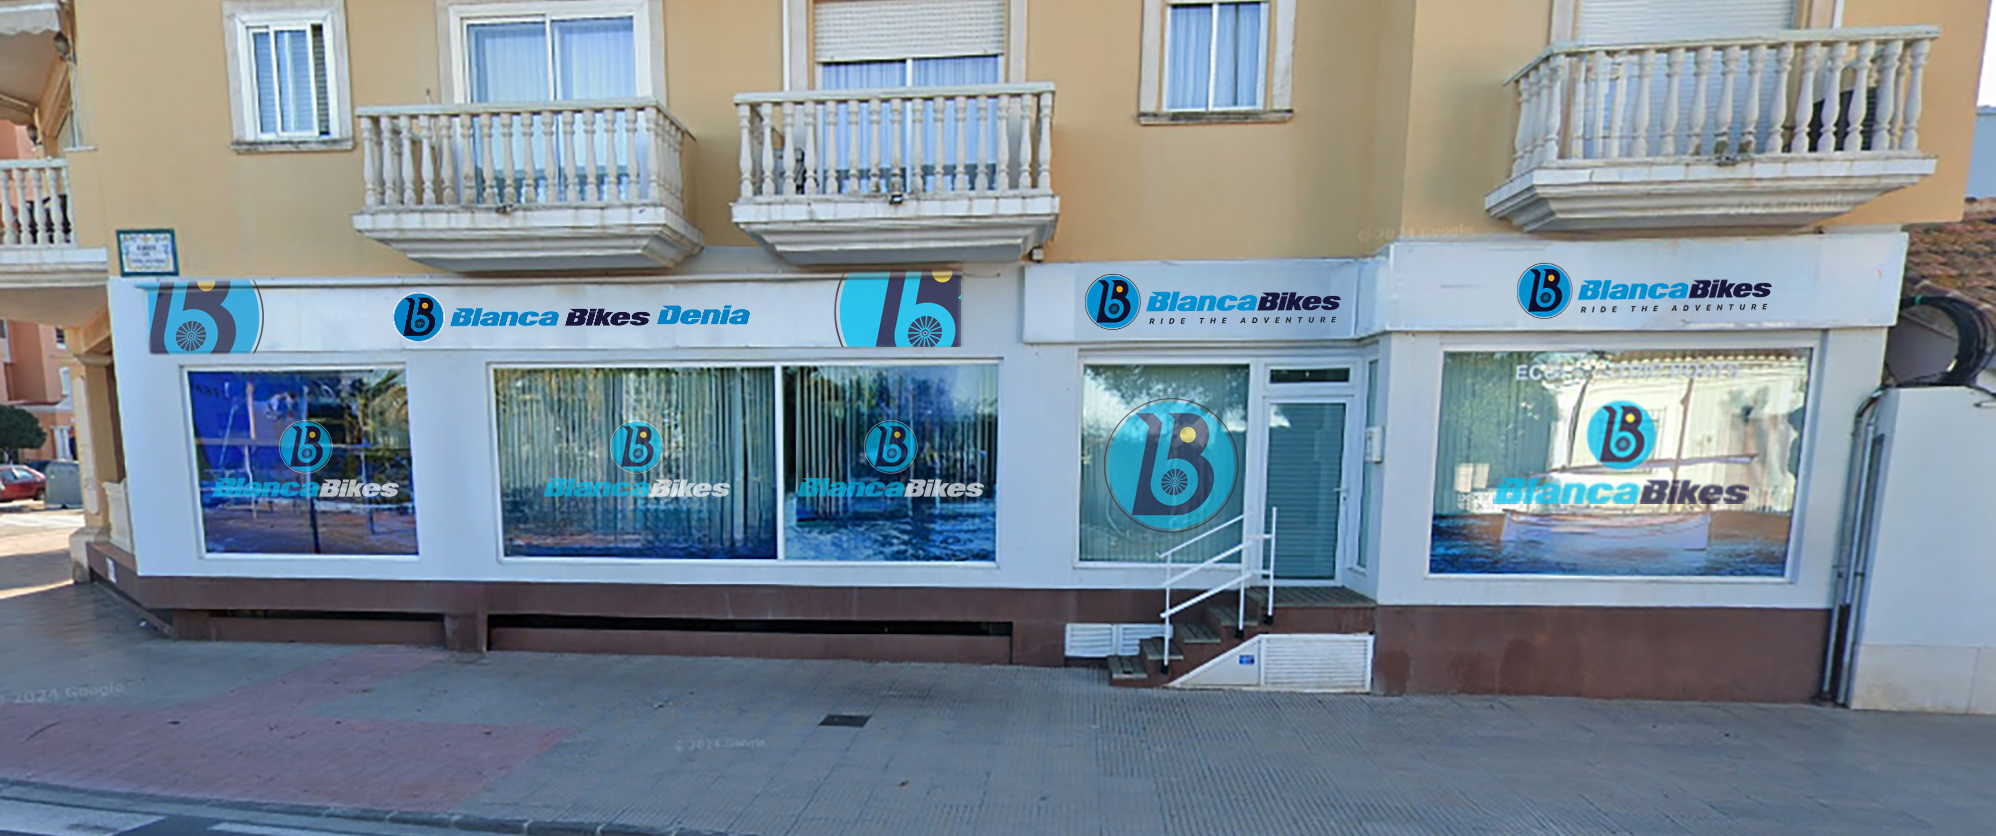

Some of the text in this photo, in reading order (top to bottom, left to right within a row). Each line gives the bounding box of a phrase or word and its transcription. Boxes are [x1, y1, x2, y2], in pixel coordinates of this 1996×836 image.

[1578, 279, 1772, 300] BlancaBikes
[1146, 291, 1341, 312] BlancaBikes
[1580, 303, 1768, 314] RIDE THE ADVENTURE
[450, 304, 751, 327] Blanca Bikes Denia
[1149, 316, 1337, 325] RIDE THE ADVENTURE
[213, 477, 400, 498] BlancaBikes
[544, 477, 731, 498] BlancaBikes
[798, 477, 985, 498] BlancaBikes
[1493, 477, 1750, 504] BlancaBikes
